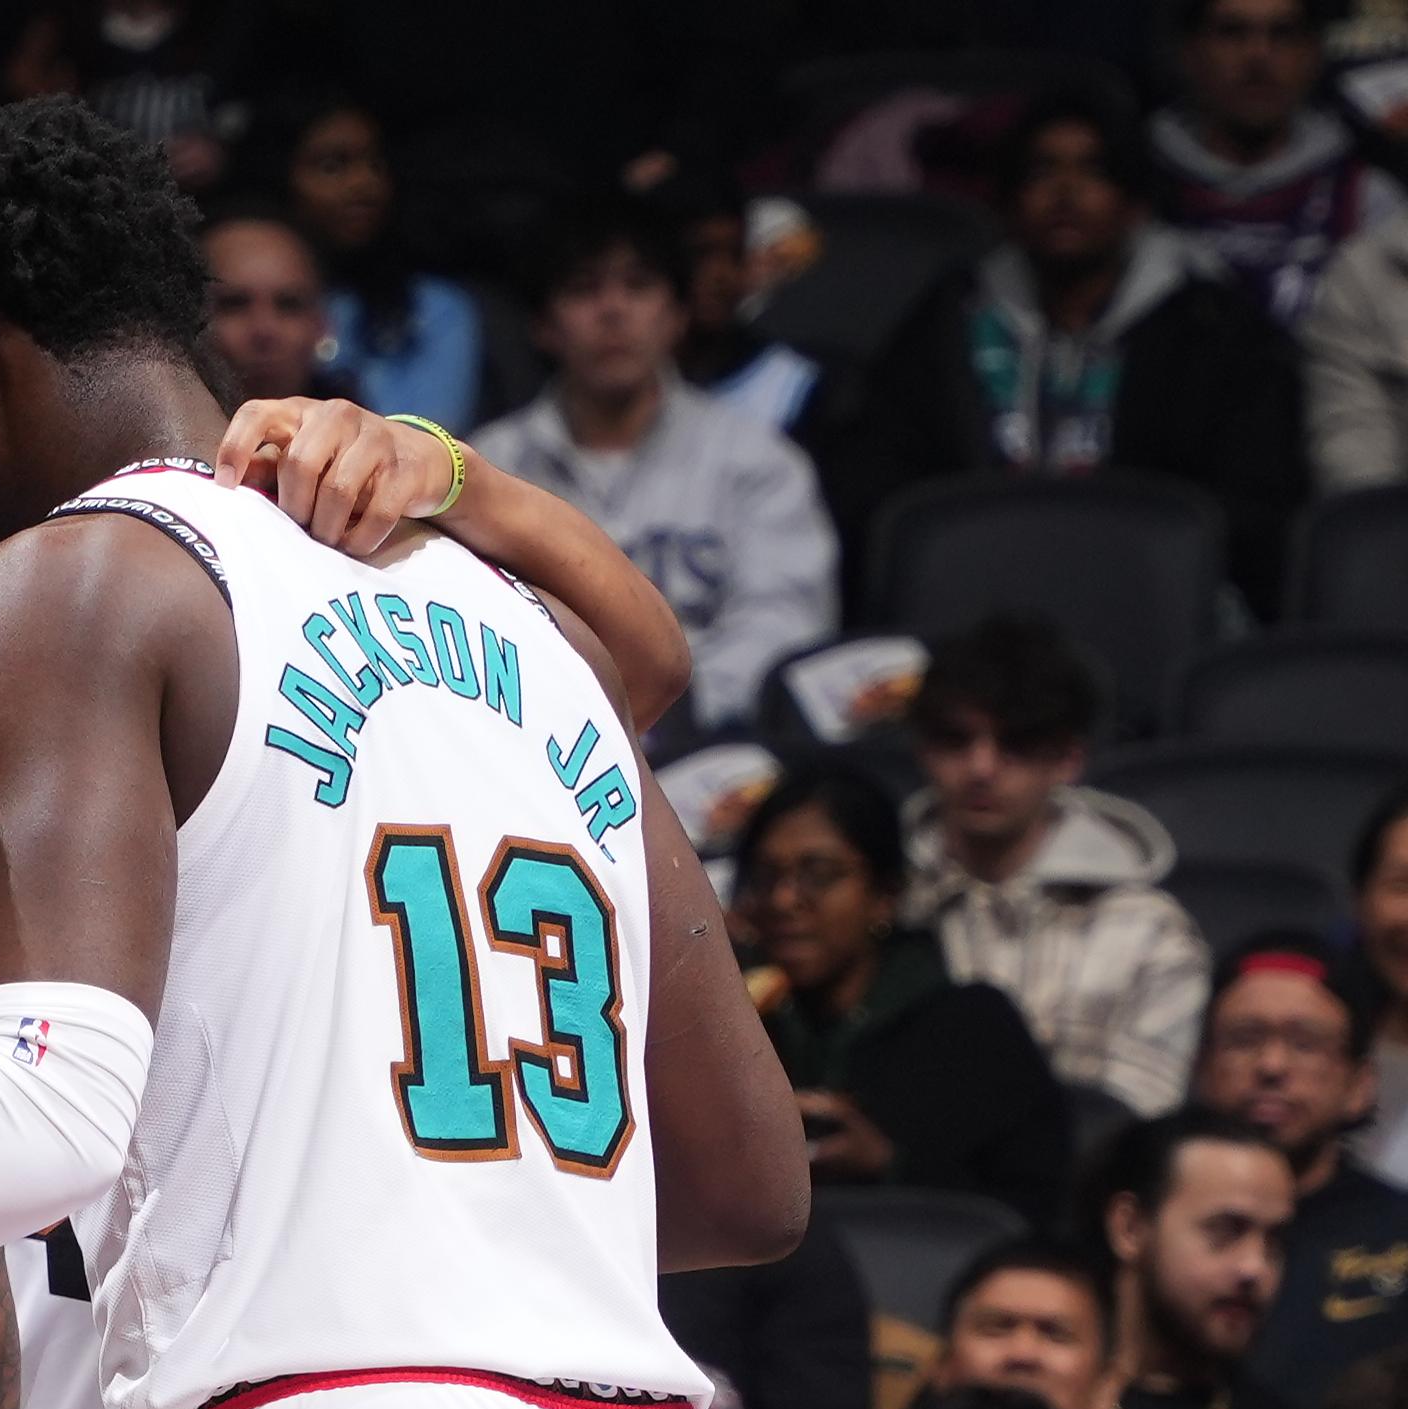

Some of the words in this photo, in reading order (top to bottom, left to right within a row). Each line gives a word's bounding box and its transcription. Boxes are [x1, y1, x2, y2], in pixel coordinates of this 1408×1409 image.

[264, 591, 523, 809] JACKSON
[546, 719, 636, 864] JR.
[363, 822, 637, 1181] 13
